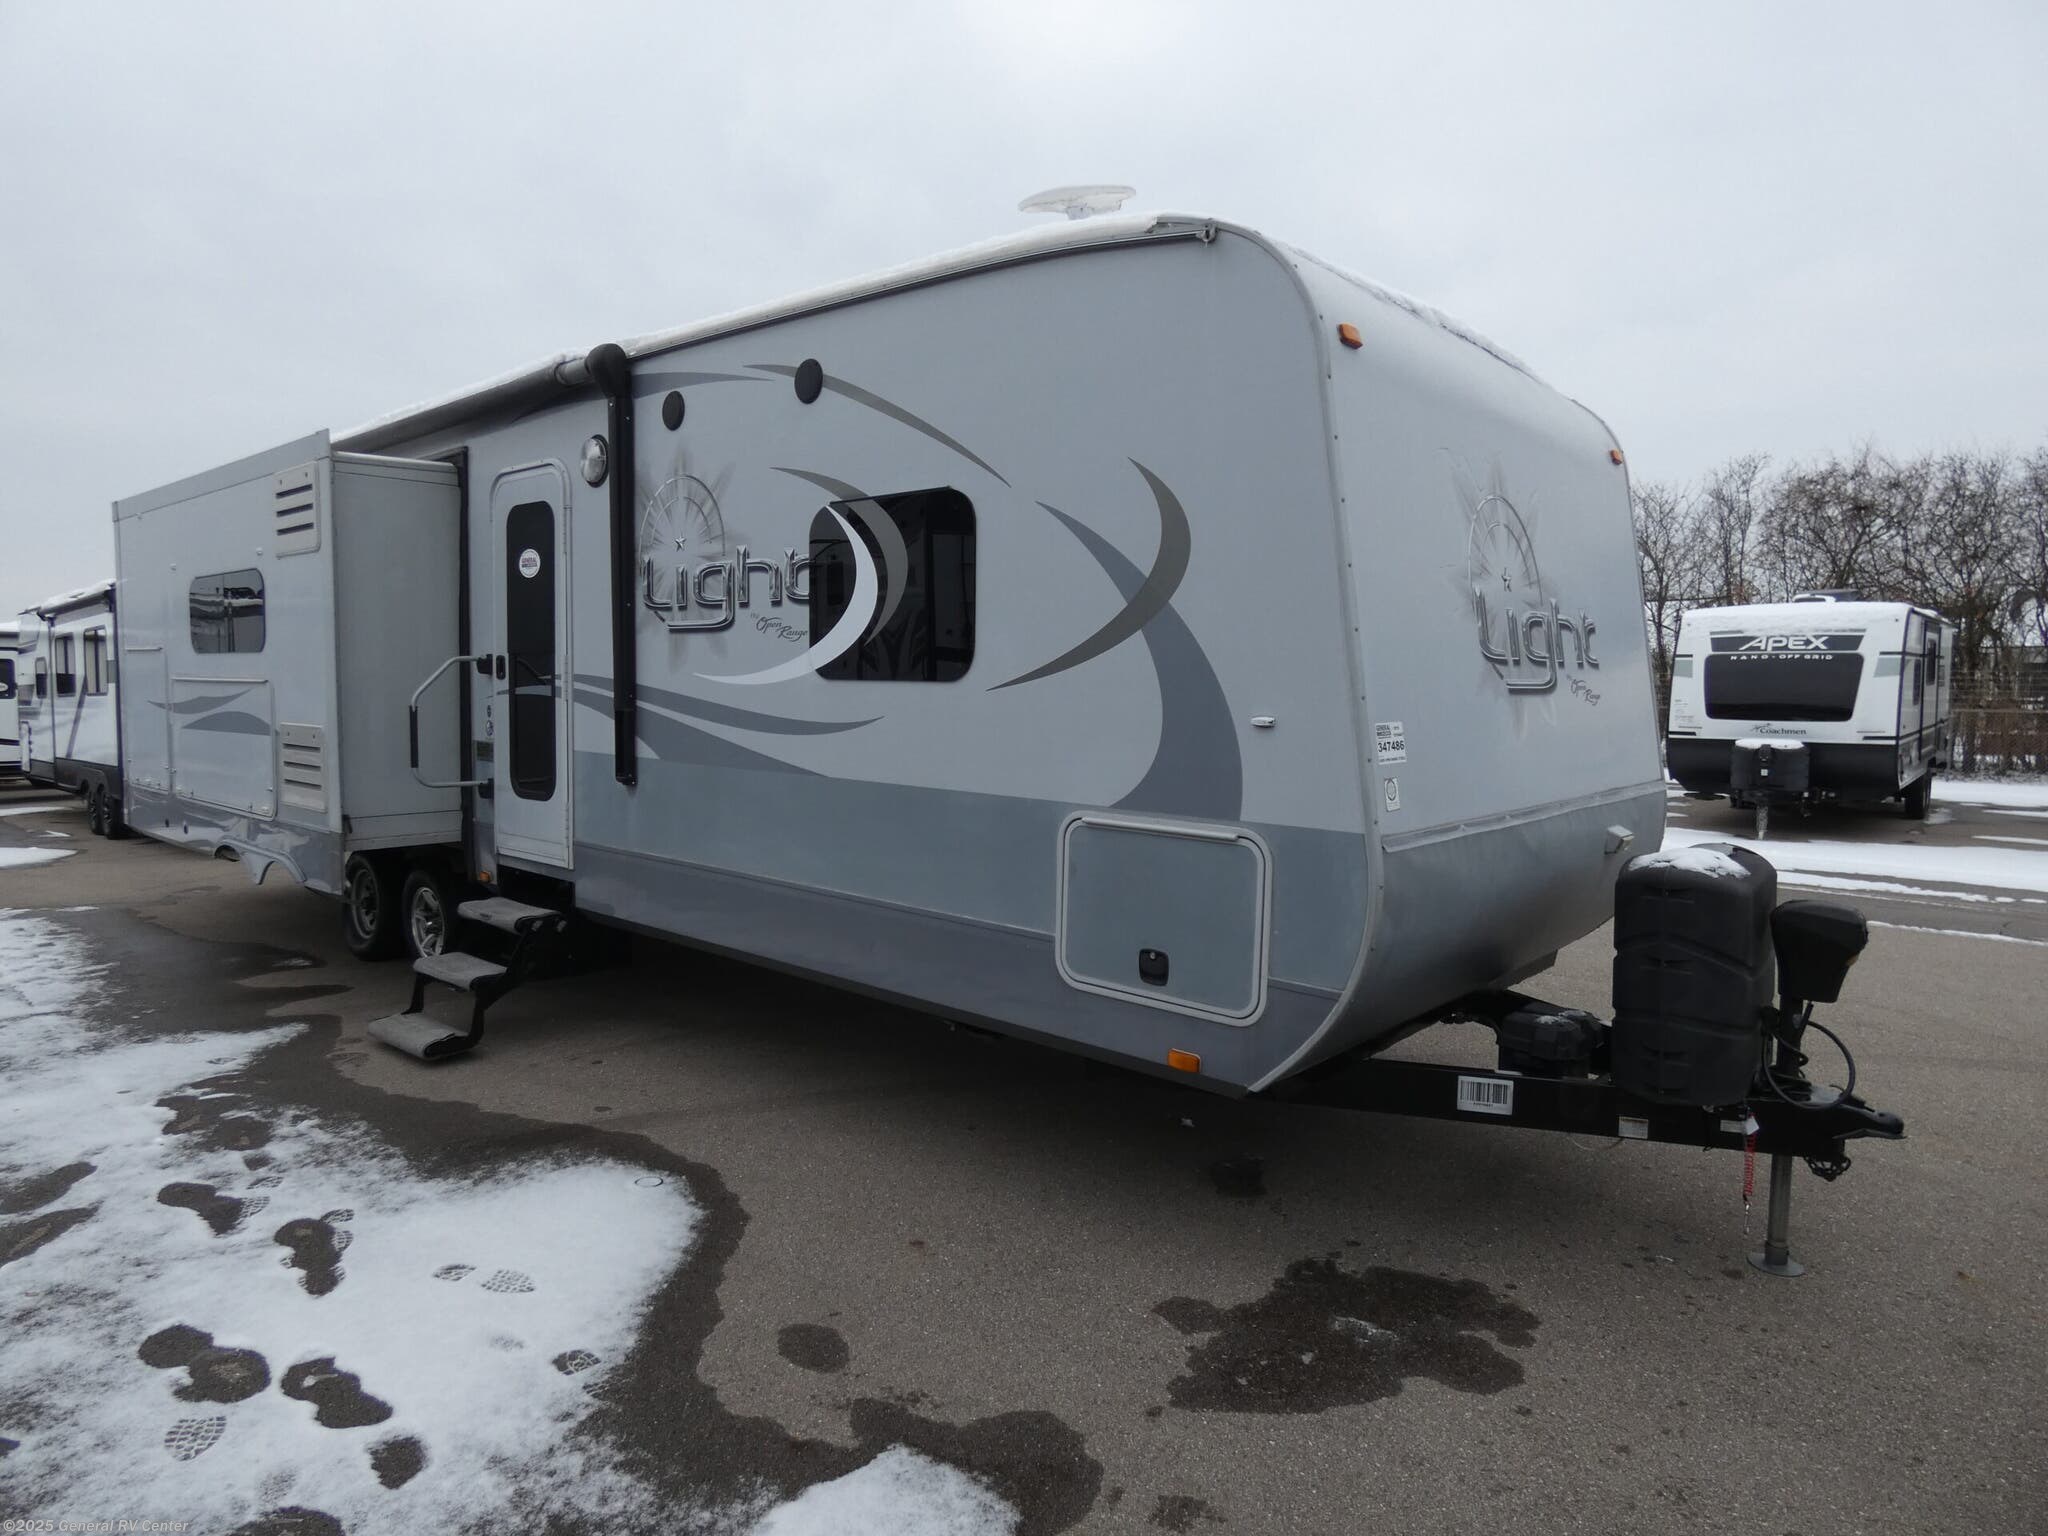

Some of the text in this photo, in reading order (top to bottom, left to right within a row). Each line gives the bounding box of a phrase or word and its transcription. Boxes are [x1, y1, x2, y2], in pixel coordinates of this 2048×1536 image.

[756, 616, 783, 634] Open
[775, 625, 808, 642] Range
[1473, 584, 1600, 695] Light
[1738, 635, 1829, 652] APEX
[1759, 727, 1807, 735] Coachmen
